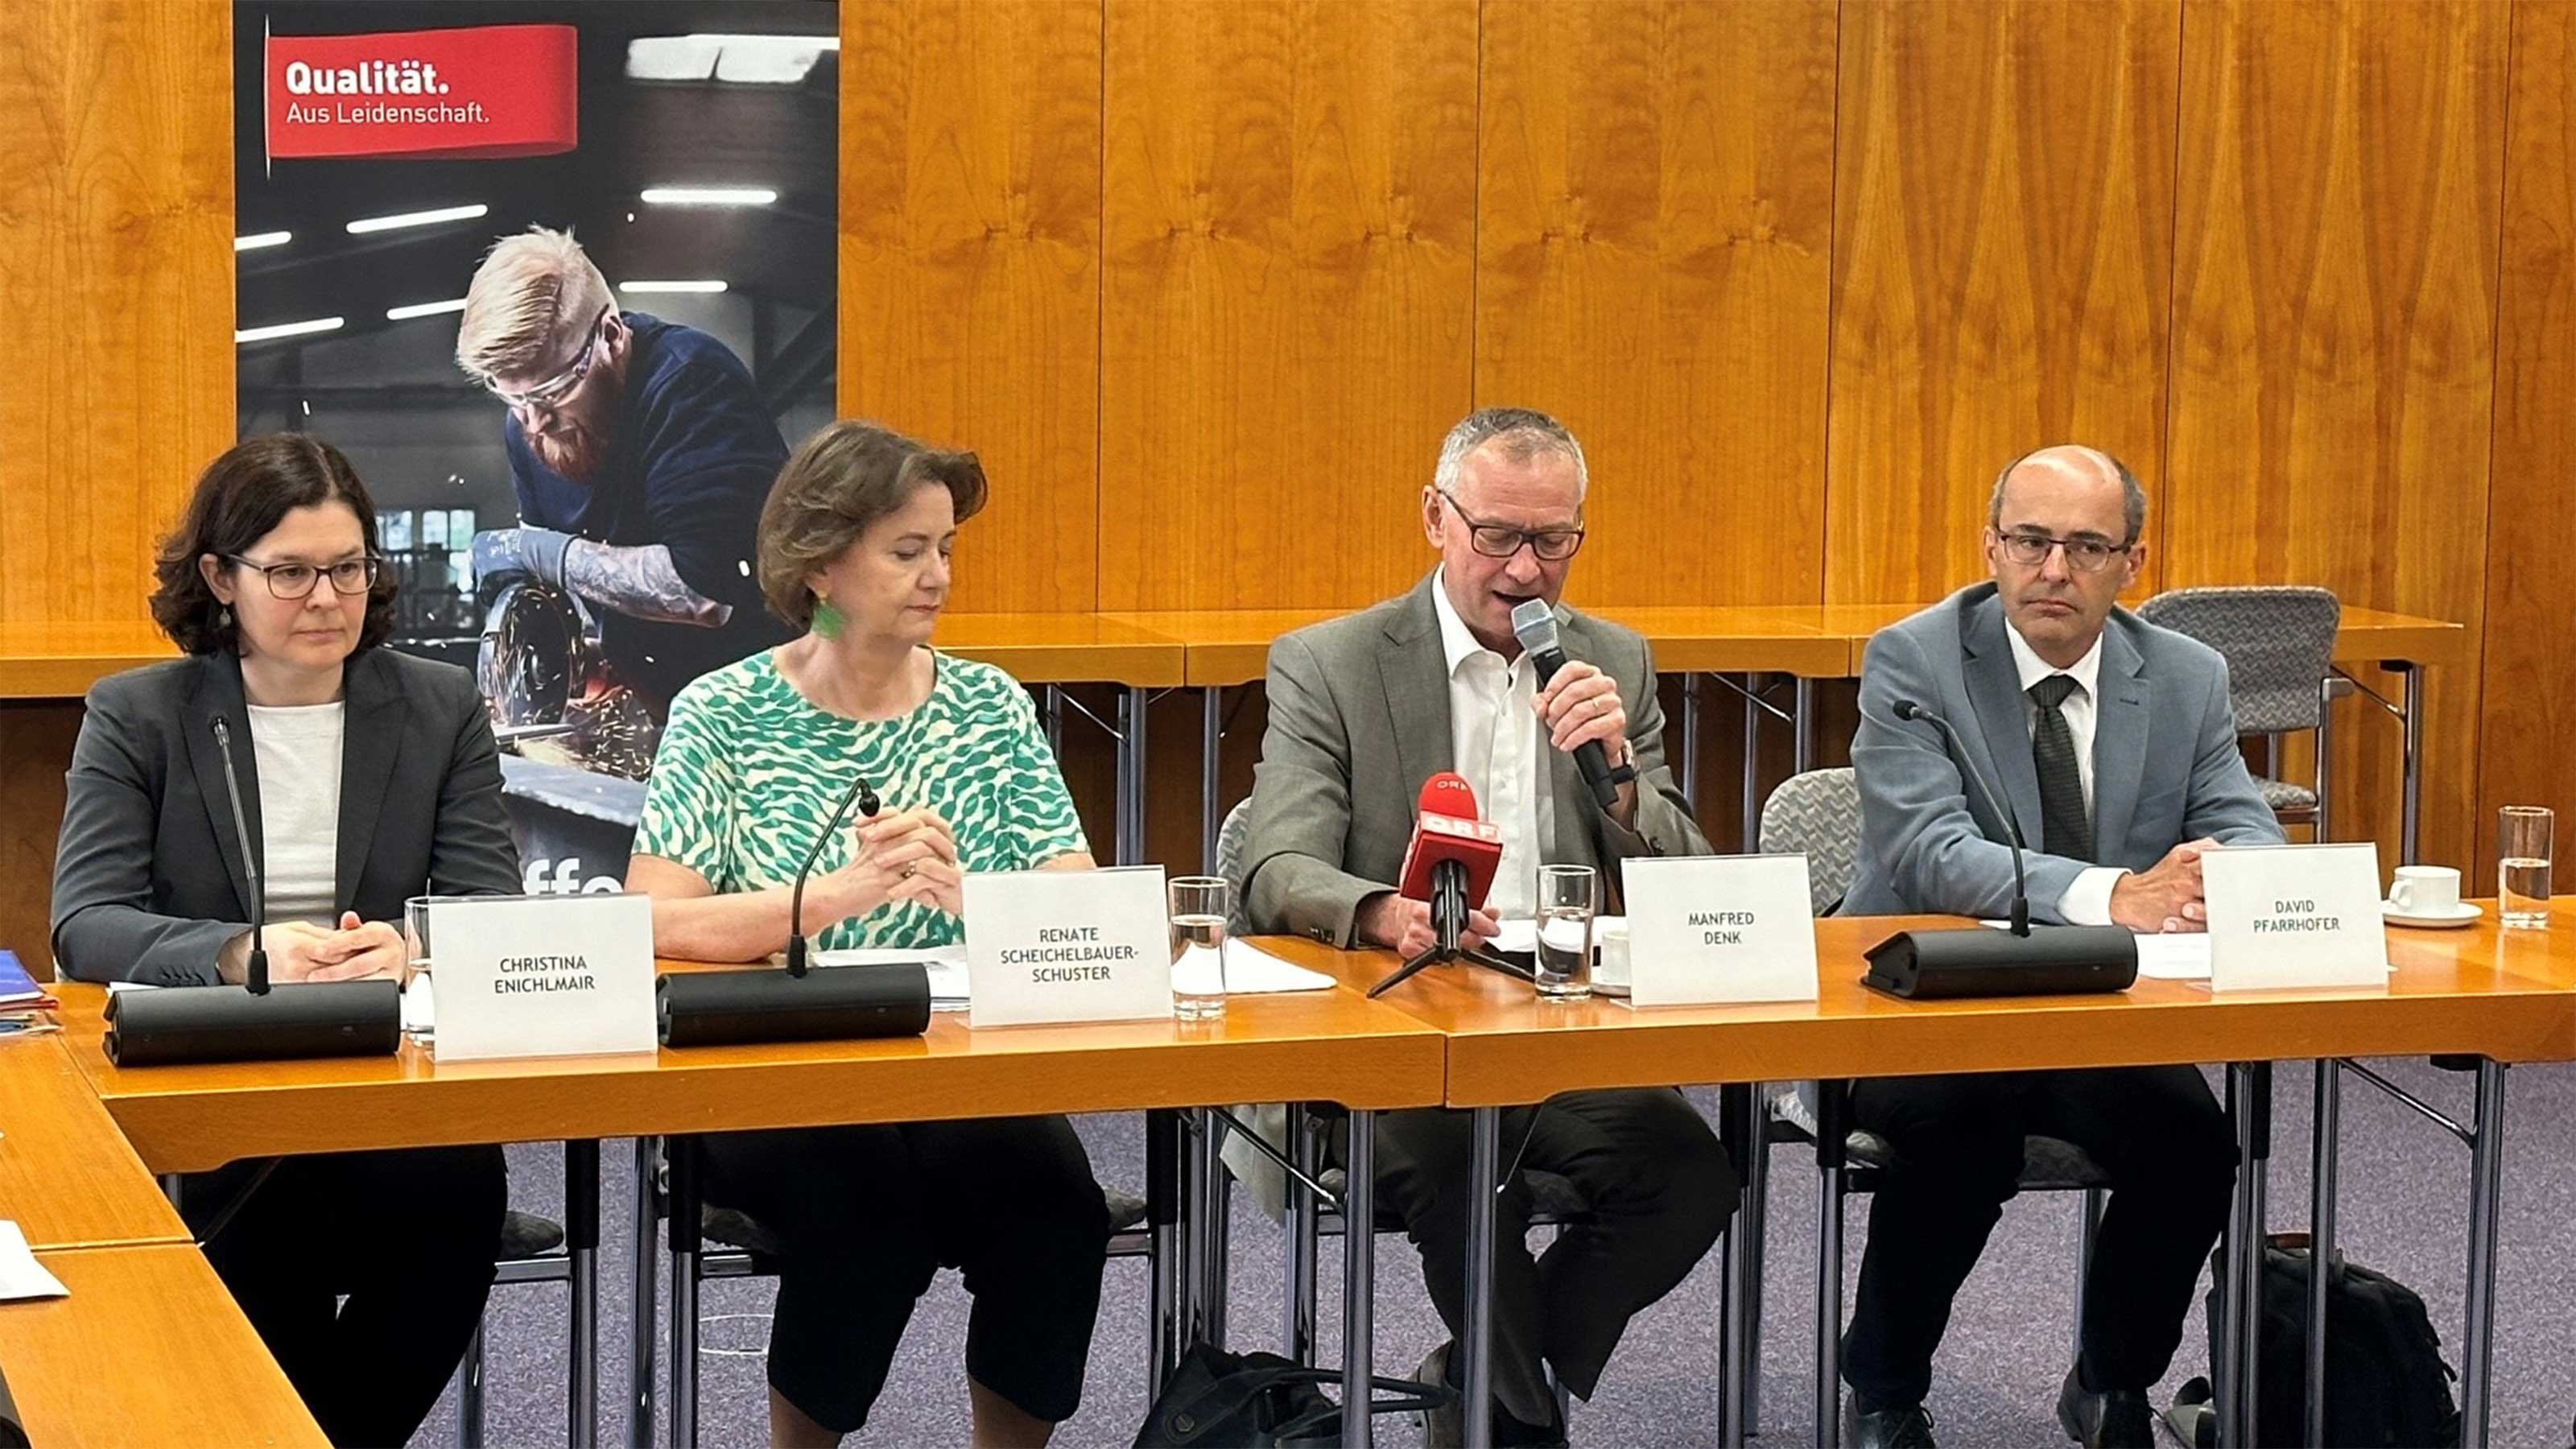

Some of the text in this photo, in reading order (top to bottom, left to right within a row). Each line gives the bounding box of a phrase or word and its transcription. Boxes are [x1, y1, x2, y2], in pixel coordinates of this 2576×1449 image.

[286, 60, 449, 95] Qualität.
[287, 101, 490, 123] Aus Leidenschaft.
[2275, 899, 2315, 914] DAVID
[1688, 911, 1755, 926] MANFRED
[2253, 917, 2340, 933] PFARRHOFER
[1039, 927, 1099, 943] RENATE
[1704, 931, 1742, 945] DENK
[1001, 945, 1139, 964] SCHEICHELBAUER-
[500, 955, 588, 973] CHRISTINA
[1032, 966, 1111, 983] SCHUSTER
[494, 975, 596, 994] ENICHLMAIR
